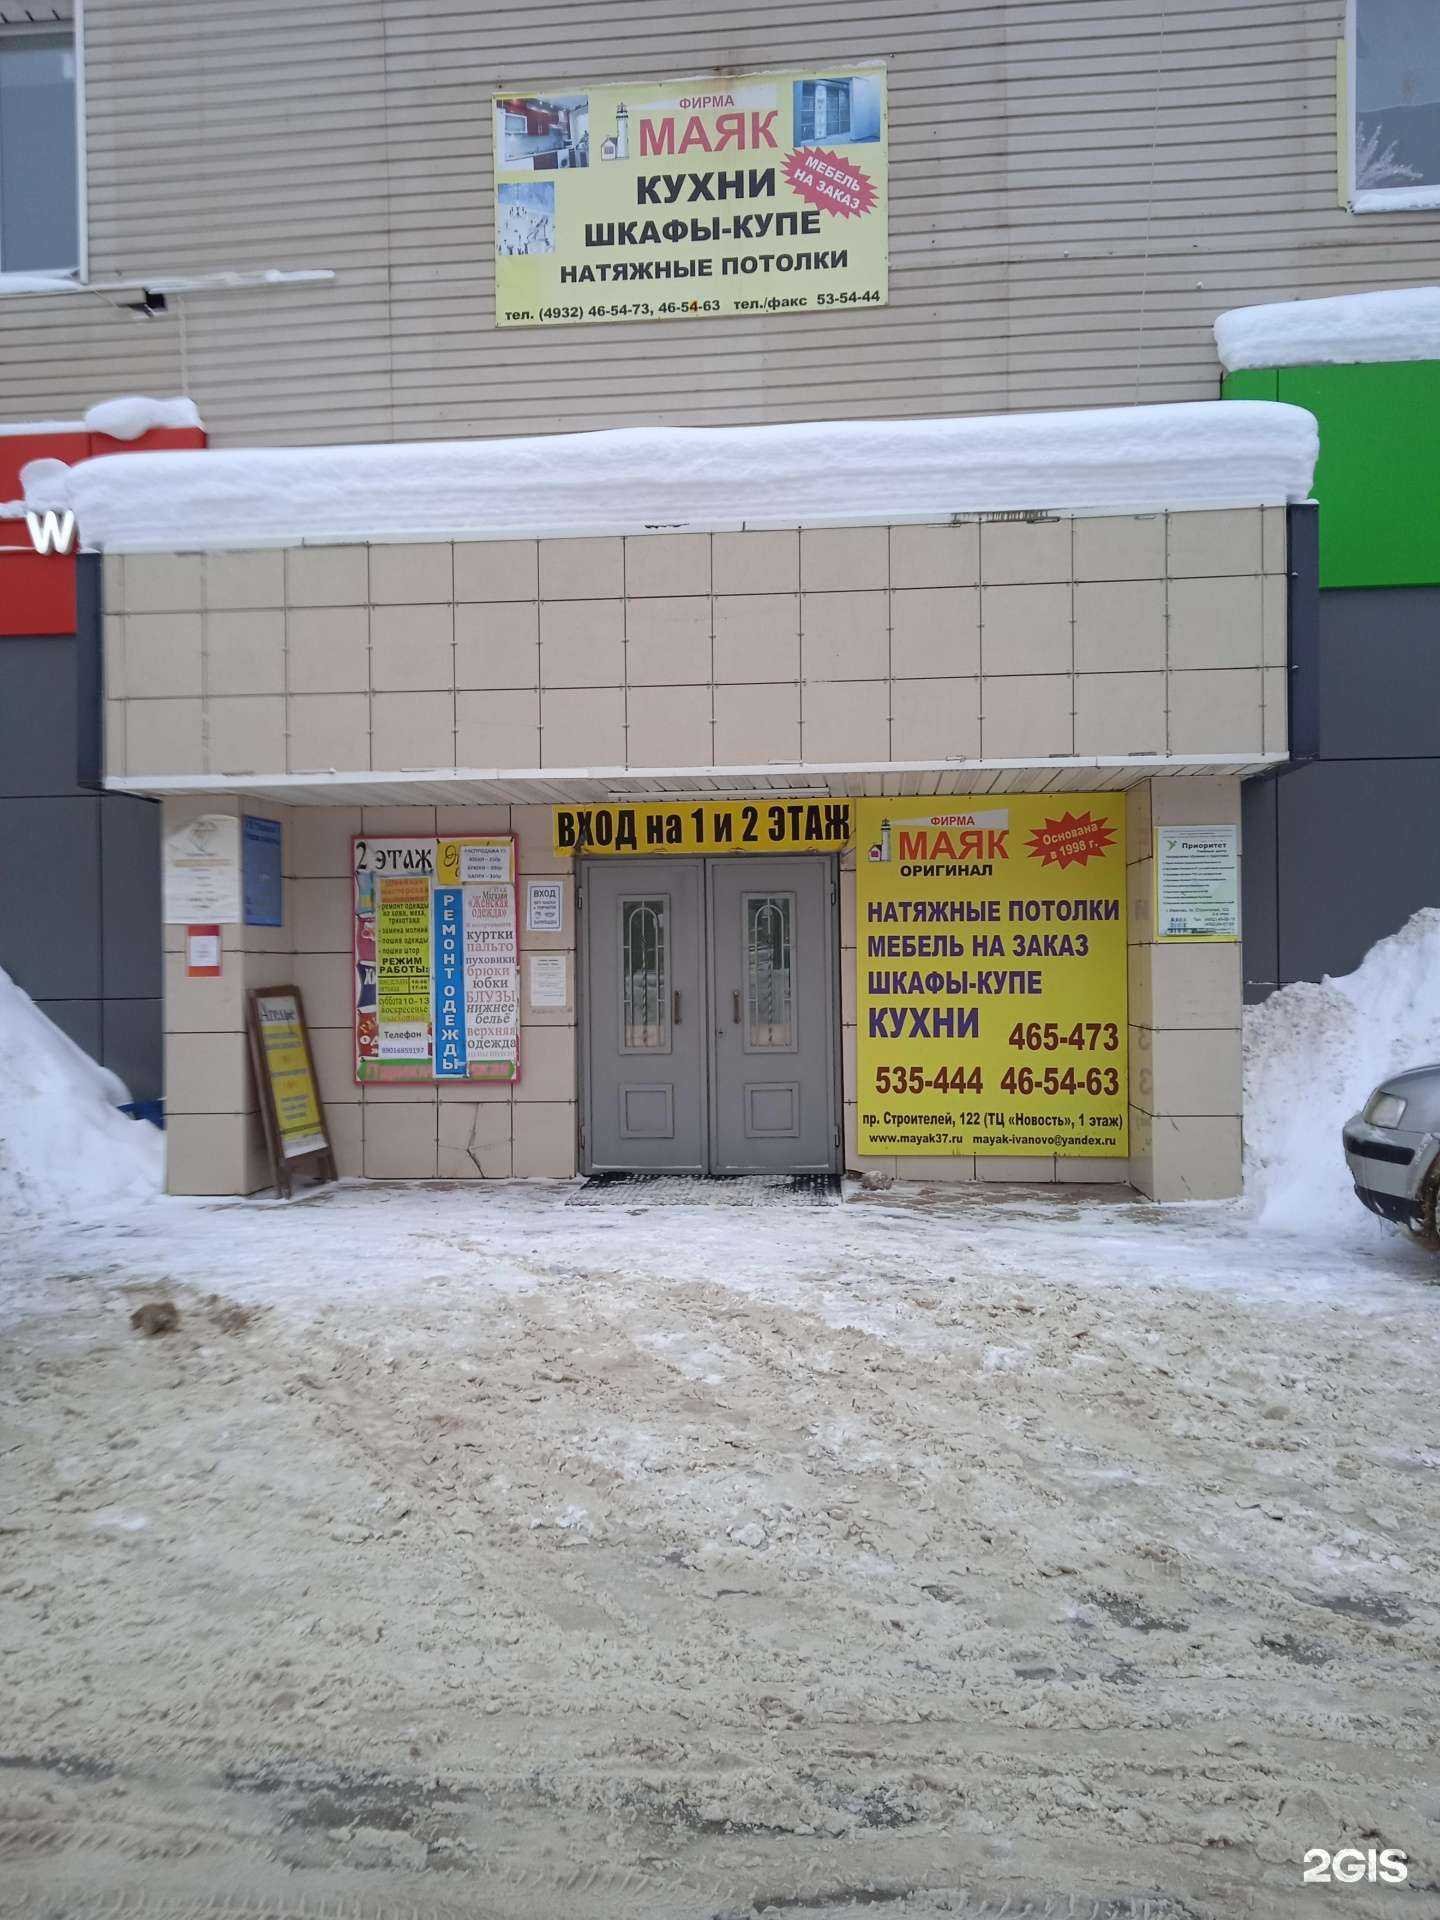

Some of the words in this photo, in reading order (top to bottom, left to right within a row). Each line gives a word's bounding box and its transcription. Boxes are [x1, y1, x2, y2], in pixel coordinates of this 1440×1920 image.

[679, 94, 735, 110] ФИРМА
[639, 110, 779, 157] МАЯК
[636, 168, 776, 205] КУХНИ
[805, 156, 860, 191] МЕБЕЛЬ
[794, 168, 814, 187] НА
[816, 180, 860, 209] ЗАКАЗ
[584, 210, 821, 248] ШКАФЫ-КУПЕ
[560, 258, 713, 284] НАТЯЖНЫЕ
[722, 249, 849, 277] ПОТОЛКИ
[505, 310, 534, 322] тел.
[538, 307, 585, 323] (4932)
[588, 302, 654, 318] 46-54-73,
[658, 299, 721, 314] 46-54-63
[733, 297, 808, 312] тел./факс
[817, 290, 881, 306] 53-54-44
[557, 809, 637, 850] ВХОД
[646, 814, 683, 844] на
[690, 808, 704, 843] 1
[713, 813, 733, 842] и
[741, 806, 759, 842] 2
[768, 804, 850, 842] ЭТАЖ
[930, 815, 976, 827] ФИРМА
[1042, 823, 1098, 845] Основана
[356, 841, 367, 870] 2
[900, 830, 1010, 861] МАЯК
[1050, 851, 1057, 860] в
[1059, 839, 1087, 856] 1998
[1088, 840, 1099, 849] г.
[900, 864, 994, 878] ОРИГИНАЛ
[533, 889, 557, 898] ВХОД
[867, 900, 1001, 923] НАТЯЖНЫЕ
[1008, 899, 1120, 922] ПОТОЛКИ
[442, 895, 456, 979] РЕМОНТ
[867, 935, 965, 958] МЕБЕЛЬ
[972, 935, 1006, 956] НА
[1013, 933, 1089, 957] ЗАКАЗ
[382, 957, 422, 965] РЕЖИМ
[868, 970, 1043, 995] ШКАФЫ-КУПЕ
[868, 1007, 980, 1039] КУХНИ
[1008, 1022, 1120, 1052] 465-473
[875, 1066, 984, 1095] 535-444
[1000, 1066, 1120, 1096] 46-54-63
[862, 1114, 880, 1127] пр.
[883, 1111, 956, 1128] Строителей,
[960, 1112, 981, 1125] 122
[983, 1112, 1005, 1128] (ТЦ
[1008, 1112, 1075, 1129] «Новость»,
[1078, 1113, 1085, 1126] 1
[1089, 1114, 1123, 1130] этаж)
[868, 1133, 963, 1146] www.mayak37.ru
[972, 1134, 1116, 1147] mayak-ivanovo@yandex.ru
